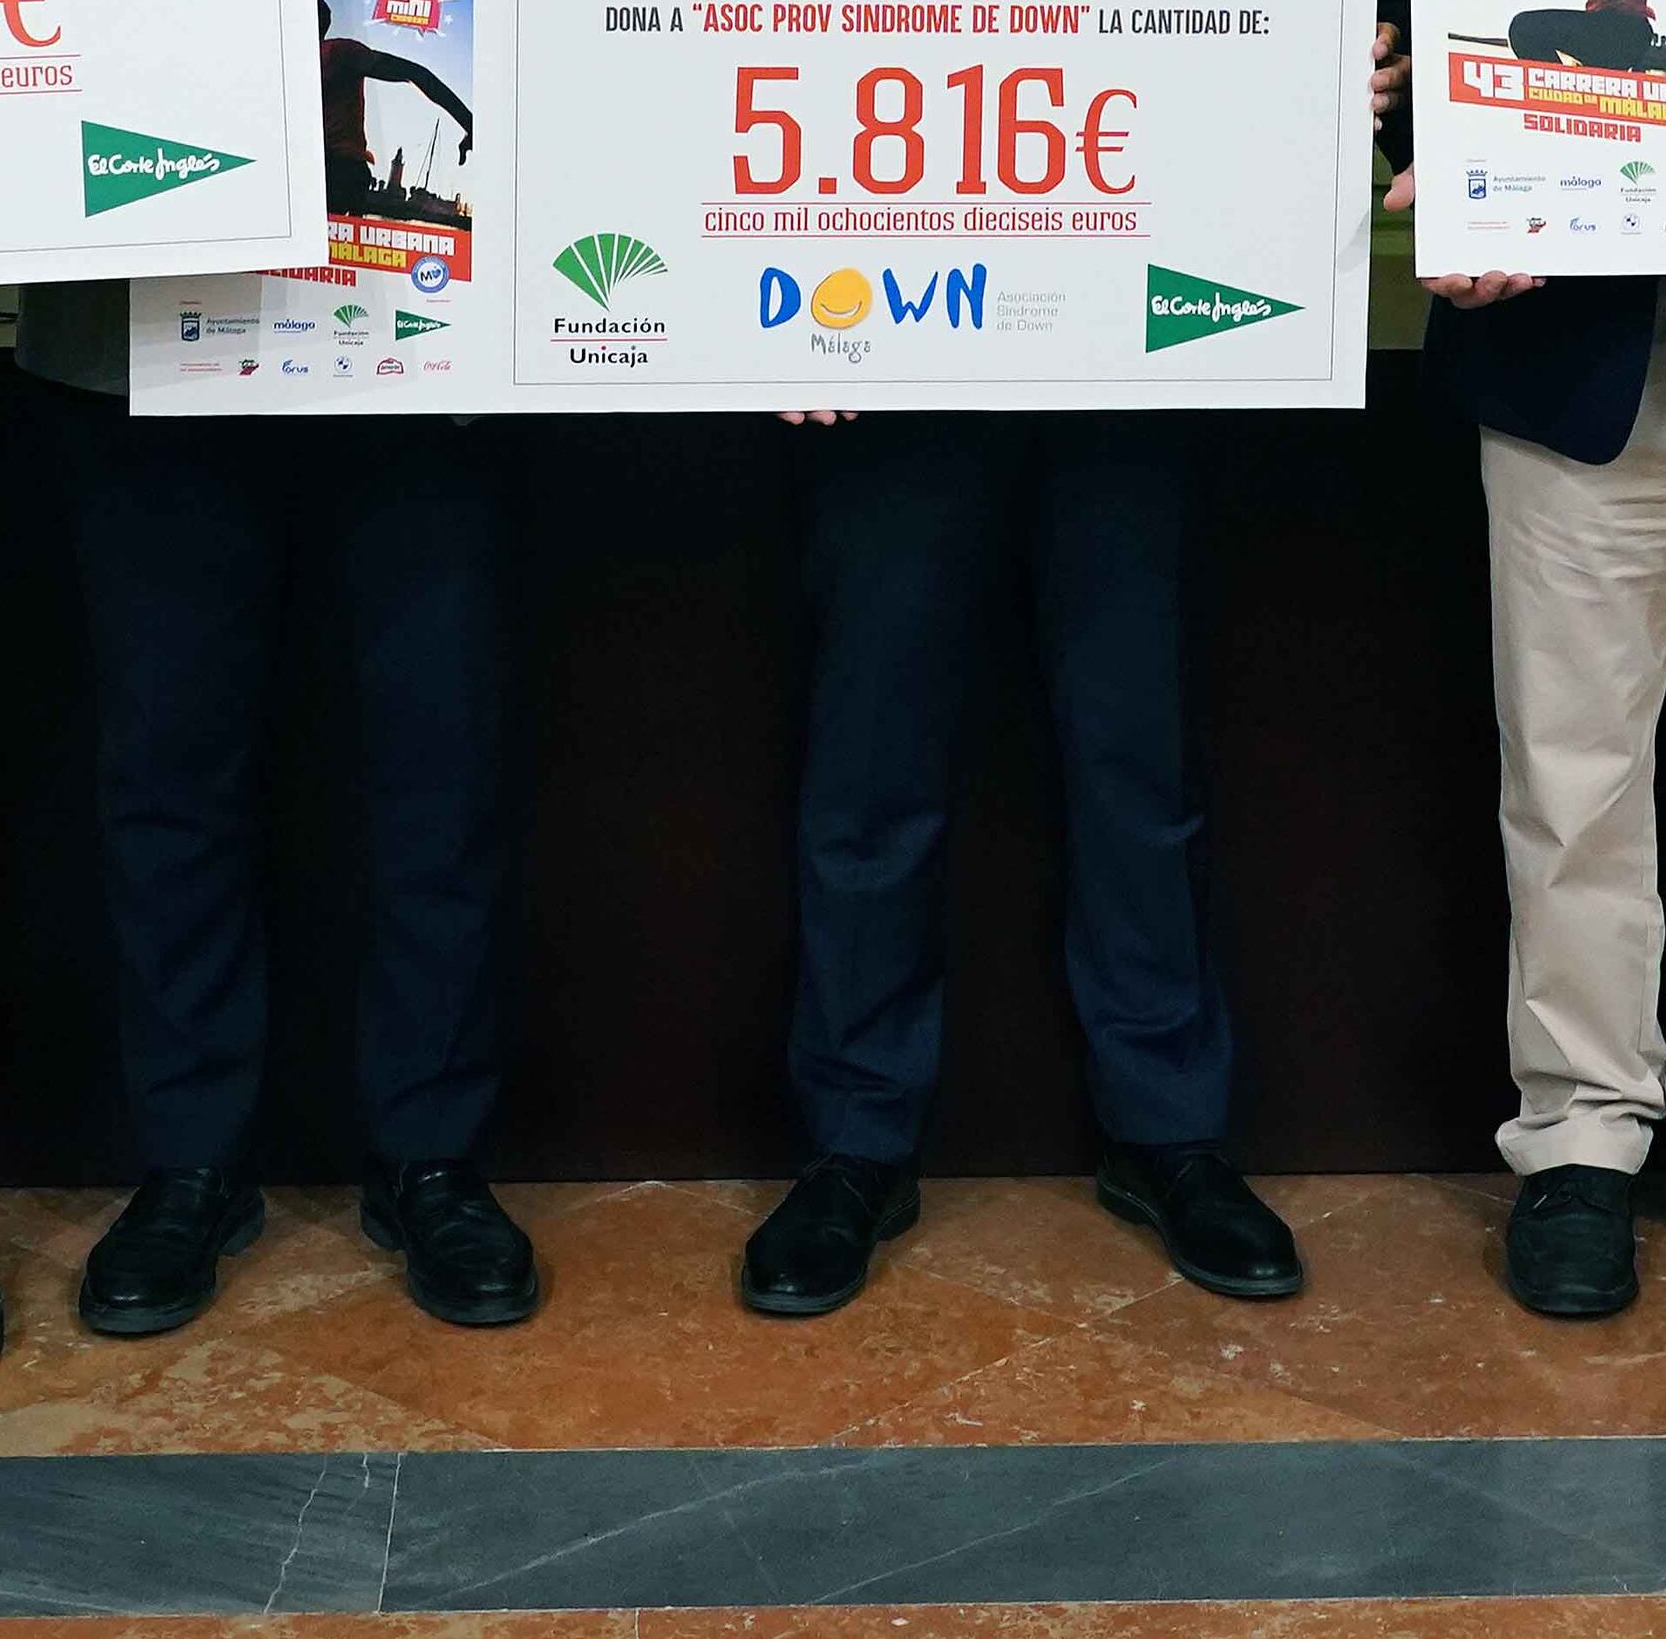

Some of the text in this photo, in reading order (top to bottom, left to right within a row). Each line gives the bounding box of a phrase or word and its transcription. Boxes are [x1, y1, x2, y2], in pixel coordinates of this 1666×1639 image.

[606, 6, 661, 32] DONA
[670, 6, 684, 32] A
[773, 4, 832, 33] PROV
[842, 4, 962, 33] SINDROME
[972, 4, 1000, 34] DE
[1099, 9, 1123, 34] LA
[1131, 9, 1230, 35] CANTIDAD
[1239, 9, 1269, 36] DE:
[1, 63, 73, 89] euros
[1462, 60, 1524, 101] 43
[1528, 67, 1638, 97] CARRERA
[733, 63, 1138, 196] 5.816€
[1524, 113, 1641, 142] SOLIDARIA
[88, 154, 109, 176] El
[109, 154, 154, 175] Corte
[704, 206, 1137, 233] cinco mil ochocientos dieciseis euros
[360, 225, 455, 256] URBANA
[1151, 295, 1170, 315] El
[1170, 296, 1210, 315] Corte
[554, 317, 665, 334] Fundación
[569, 345, 648, 367] Unicaja
[810, 332, 871, 363] Málaga
